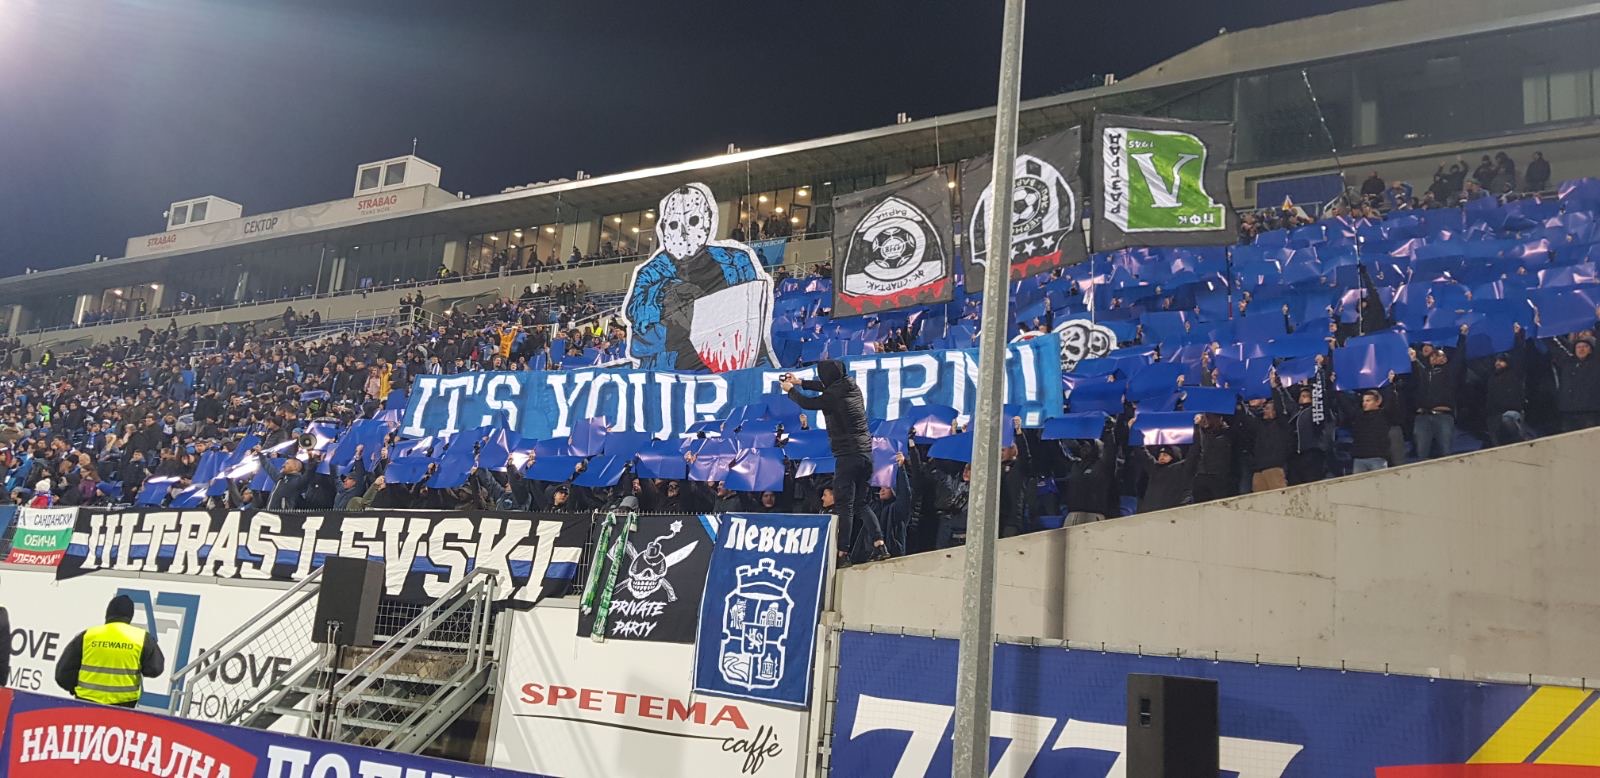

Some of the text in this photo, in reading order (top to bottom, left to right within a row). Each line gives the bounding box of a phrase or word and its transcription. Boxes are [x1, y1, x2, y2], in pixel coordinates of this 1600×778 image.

[1108, 132, 1122, 215] РАЗГРАД
[357, 195, 398, 211] STRABAG
[876, 207, 908, 221] ВАРНА
[244, 217, 279, 235] СЕКТОР
[1013, 216, 1043, 234] ЧЕРН
[146, 233, 177, 247] STRABAG
[402, 373, 521, 439] IT'S
[547, 371, 728, 442] YOUR
[34, 513, 73, 528] САНДАНСКИ
[24, 533, 58, 548] ОБИЧА
[723, 516, 820, 554] Левски
[80, 511, 282, 579] ULTRAS
[608, 599, 667, 619] PRIVATE
[611, 620, 657, 637] PARTY
[9, 628, 60, 661] OVE
[91, 640, 134, 650] STEWARD
[8, 665, 43, 691] MES
[519, 682, 750, 730] SPETEMA
[721, 724, 783, 775] caffè
